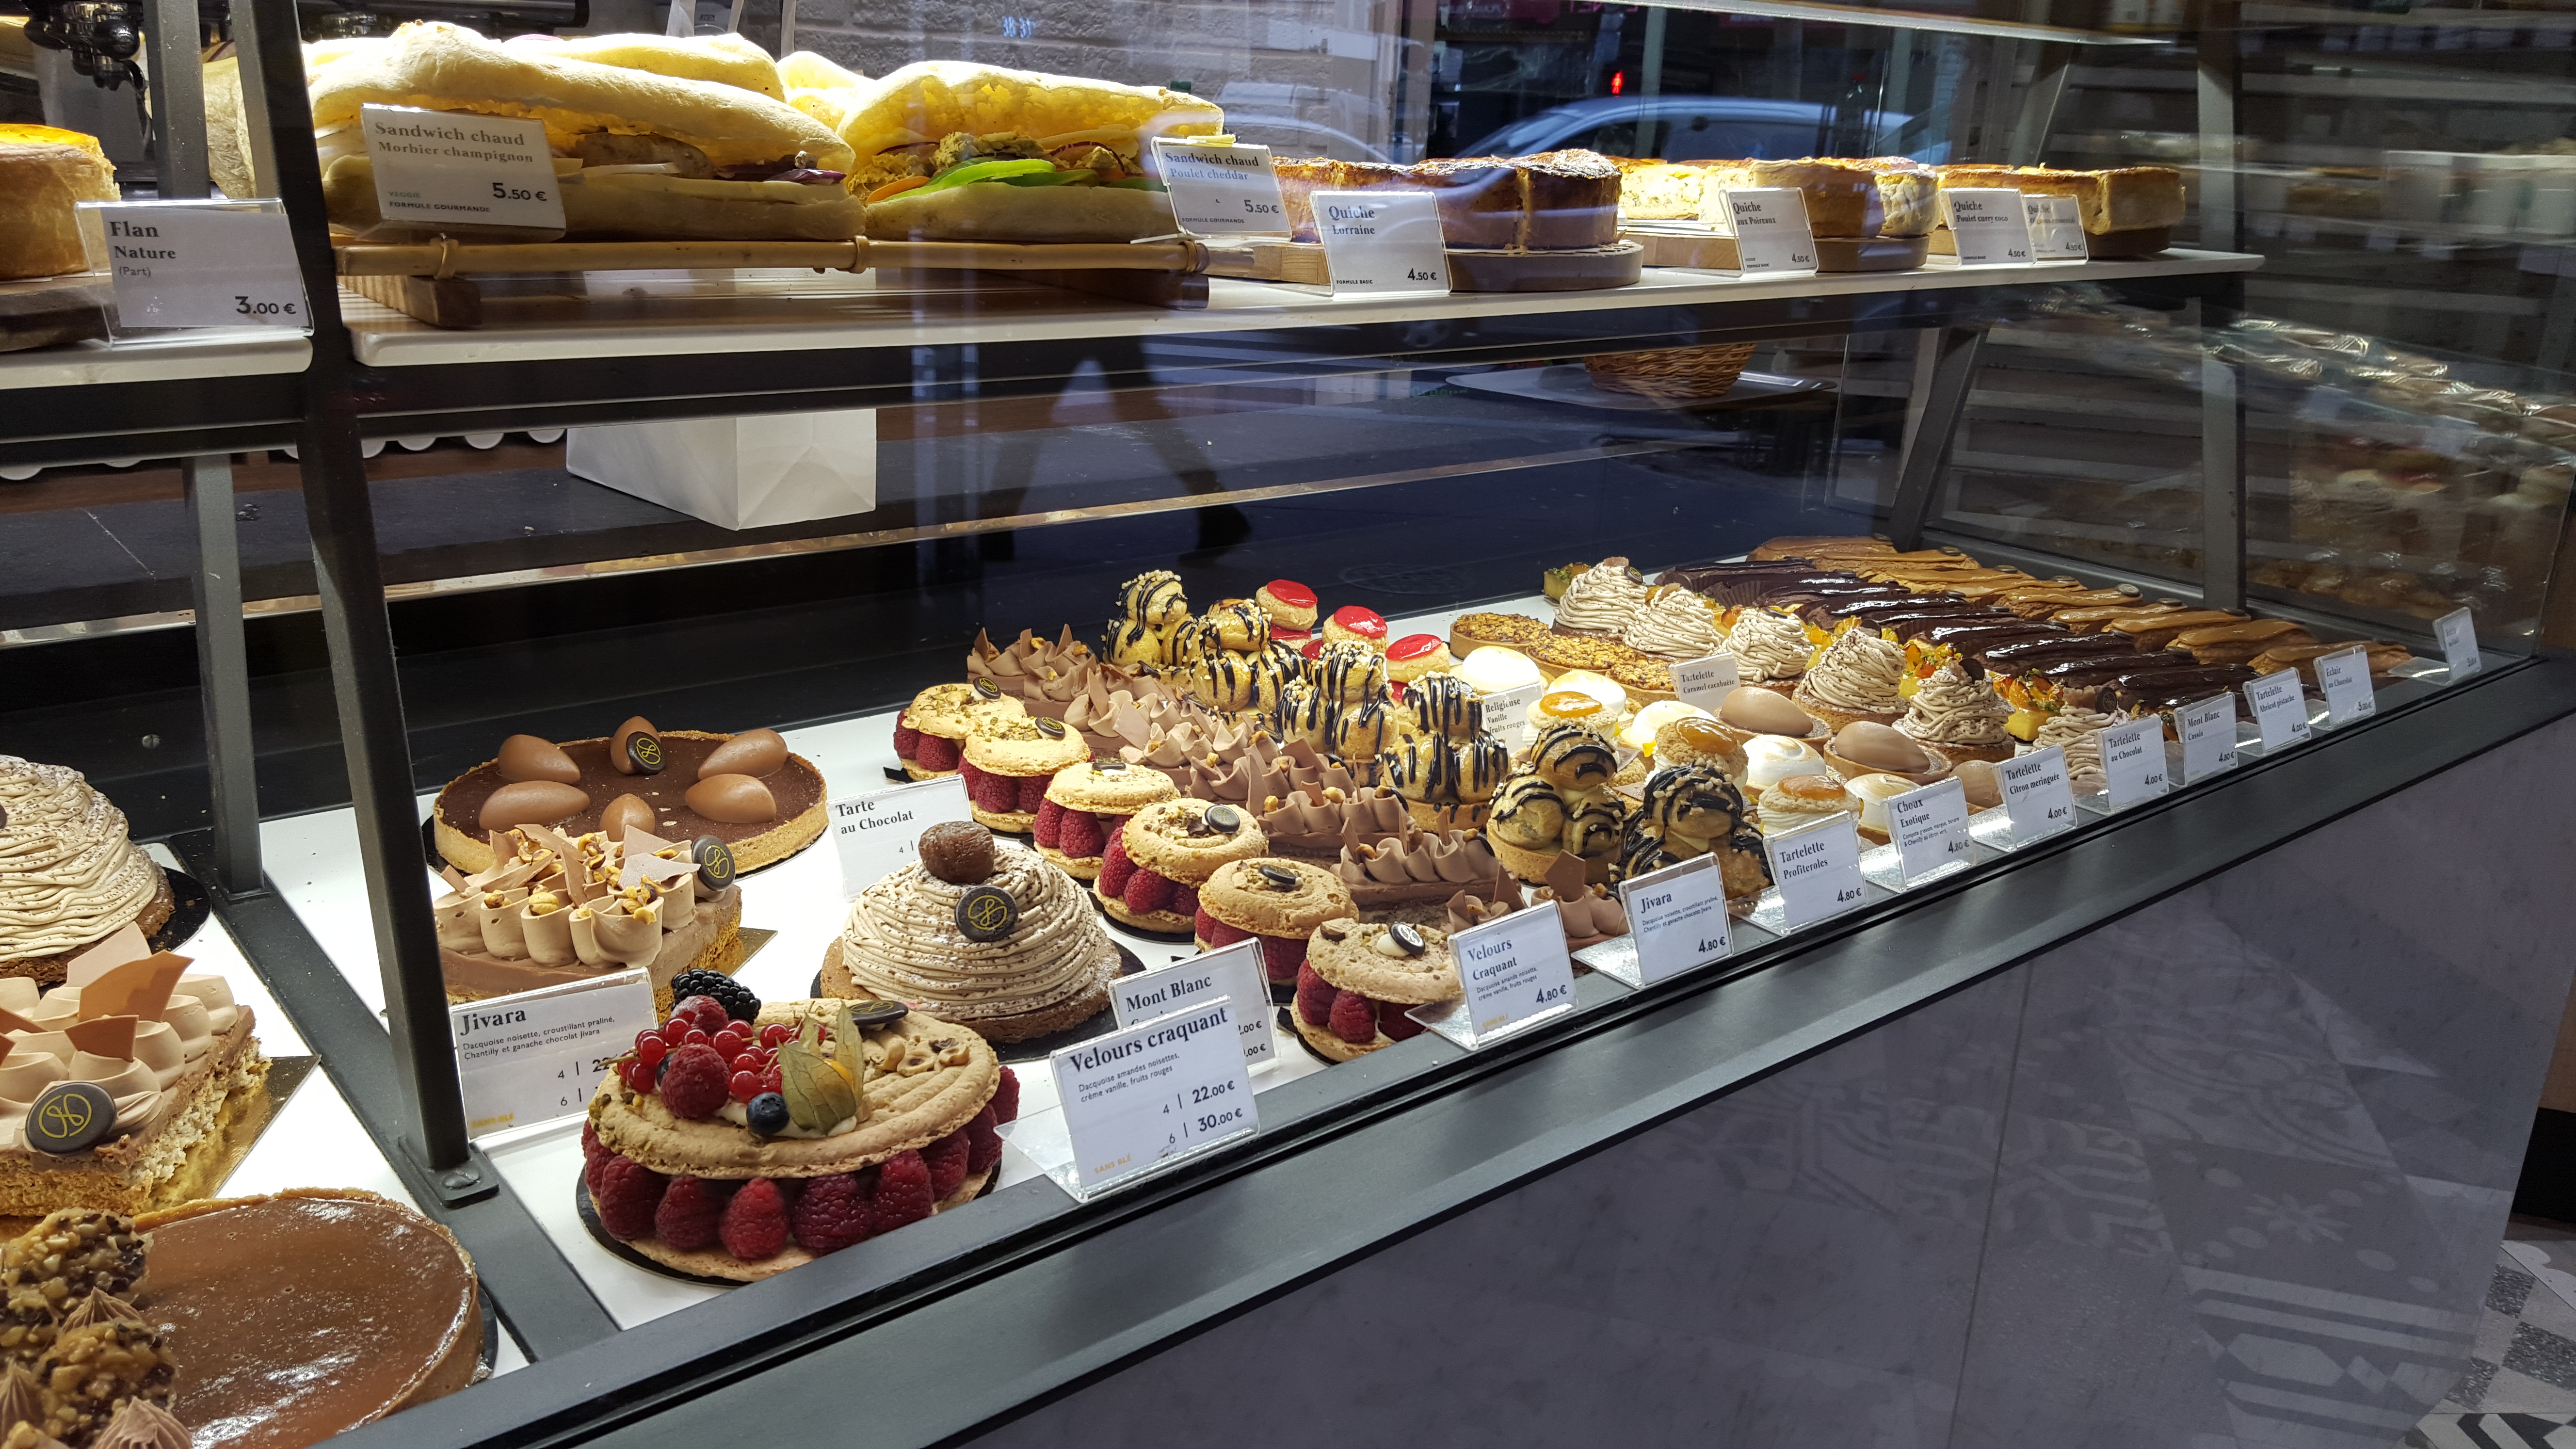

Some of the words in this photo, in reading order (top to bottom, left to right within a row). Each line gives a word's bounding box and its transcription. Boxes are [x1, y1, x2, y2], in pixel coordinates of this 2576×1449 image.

[376, 122, 464, 141] Sandwich
[471, 130, 525, 145] chaud
[378, 142, 438, 155] Morbier
[444, 147, 533, 162] champignon
[1165, 152, 1222, 164] Sandwich
[1225, 154, 1259, 166] chaud
[1171, 168, 1203, 178] Poulet
[1208, 170, 1248, 180] cheddar
[492, 182, 531, 200] 5.50
[535, 191, 547, 201] €
[435, 204, 490, 212] GOURMANDE
[1244, 199, 1269, 213] 5.50
[1329, 206, 1375, 220] Quiche
[1733, 202, 1761, 214] Quiche
[1954, 201, 1982, 212] Quiche
[110, 221, 159, 237] Flan
[1333, 225, 1375, 234] Lorraine
[114, 245, 176, 259] Nature
[119, 266, 151, 277] (Part)
[1408, 268, 1428, 280] 4.50
[235, 296, 279, 314] 3.00
[284, 303, 296, 314] €
[1681, 671, 1714, 682] Tartelette
[2326, 666, 2341, 676] Eclair
[1683, 683, 1707, 693] Caramel
[2256, 686, 2282, 700] Tartelette
[1485, 699, 1521, 713] Religieuse
[2260, 700, 2276, 713] Abricot
[2277, 695, 2295, 708] pistache
[1487, 713, 1507, 724] Vanille
[2188, 716, 2203, 728] Mont
[2205, 711, 2220, 722] Blanc
[1489, 724, 1505, 734] fruits
[1507, 720, 1525, 729] rouges
[2292, 724, 2302, 733] 4.00
[2109, 732, 2141, 748] Tartelette
[2189, 730, 2203, 740] Cassis
[2119, 746, 2142, 759] Chocolat
[2006, 764, 2041, 780] Tartelette
[2010, 784, 2029, 794] Citron
[2031, 773, 2060, 789] meringuée
[2145, 775, 2158, 785] 4.00
[836, 801, 875, 817] Tarte
[1898, 799, 1923, 813] Choux
[2048, 807, 2061, 819] 4.00
[841, 825, 855, 834] au
[859, 810, 914, 830] Chocolat
[1900, 813, 1930, 828] Exotique
[1780, 841, 1825, 863] Tartelette
[1948, 840, 1963, 853] 4.80
[1784, 858, 1828, 880] Profiteroles
[1837, 889, 1855, 902] 4.80
[1856, 888, 1862, 896] €
[1641, 894, 1672, 913] Jivara
[1684, 909, 1700, 918] chocolat
[1468, 939, 1512, 962] Velours
[1699, 939, 1718, 952] 4.80
[1720, 937, 1725, 945] €
[1473, 957, 1517, 981] Craquant
[1477, 981, 1500, 993] Dacquoise
[1501, 974, 1518, 983] amande
[1519, 967, 1538, 977] noisette,
[1523, 975, 1537, 983] rouges
[1126, 989, 1167, 1012] Mont
[1172, 975, 1212, 998] Blanc
[1536, 988, 1558, 1003] 4.80
[1560, 985, 1566, 995] €
[460, 1010, 527, 1036] Jivara
[463, 1038, 504, 1050] Dacquoise
[507, 1030, 541, 1043] noisette,
[544, 1022, 585, 1036] croustillant
[588, 1015, 615, 1030] praliné,
[465, 1047, 499, 1060] Chantilly
[513, 1040, 543, 1052] ganache
[546, 1033, 577, 1044] chocolat
[580, 1029, 600, 1039] Jivara
[1070, 1039, 1143, 1073] Velours
[1147, 1007, 1228, 1048] craquant
[558, 1070, 564, 1079] 4
[1079, 1075, 1114, 1092] Dacquoise
[1117, 1065, 1145, 1079] amandes
[1148, 1053, 1179, 1068] noisettes,
[1081, 1091, 1103, 1102] crème
[1105, 1082, 1128, 1094] vanille,
[1130, 1075, 1148, 1085] fruits
[1151, 1066, 1173, 1078] rouges
[561, 1096, 567, 1106] 6
[1163, 1104, 1170, 1114] 4
[1192, 1085, 1225, 1104] 22.00
[1227, 1080, 1235, 1090] €
[1169, 1133, 1175, 1143] 6
[1198, 1111, 1233, 1131] 30.00
[1235, 1108, 1242, 1118] €
[1095, 1161, 1115, 1174] SANS
